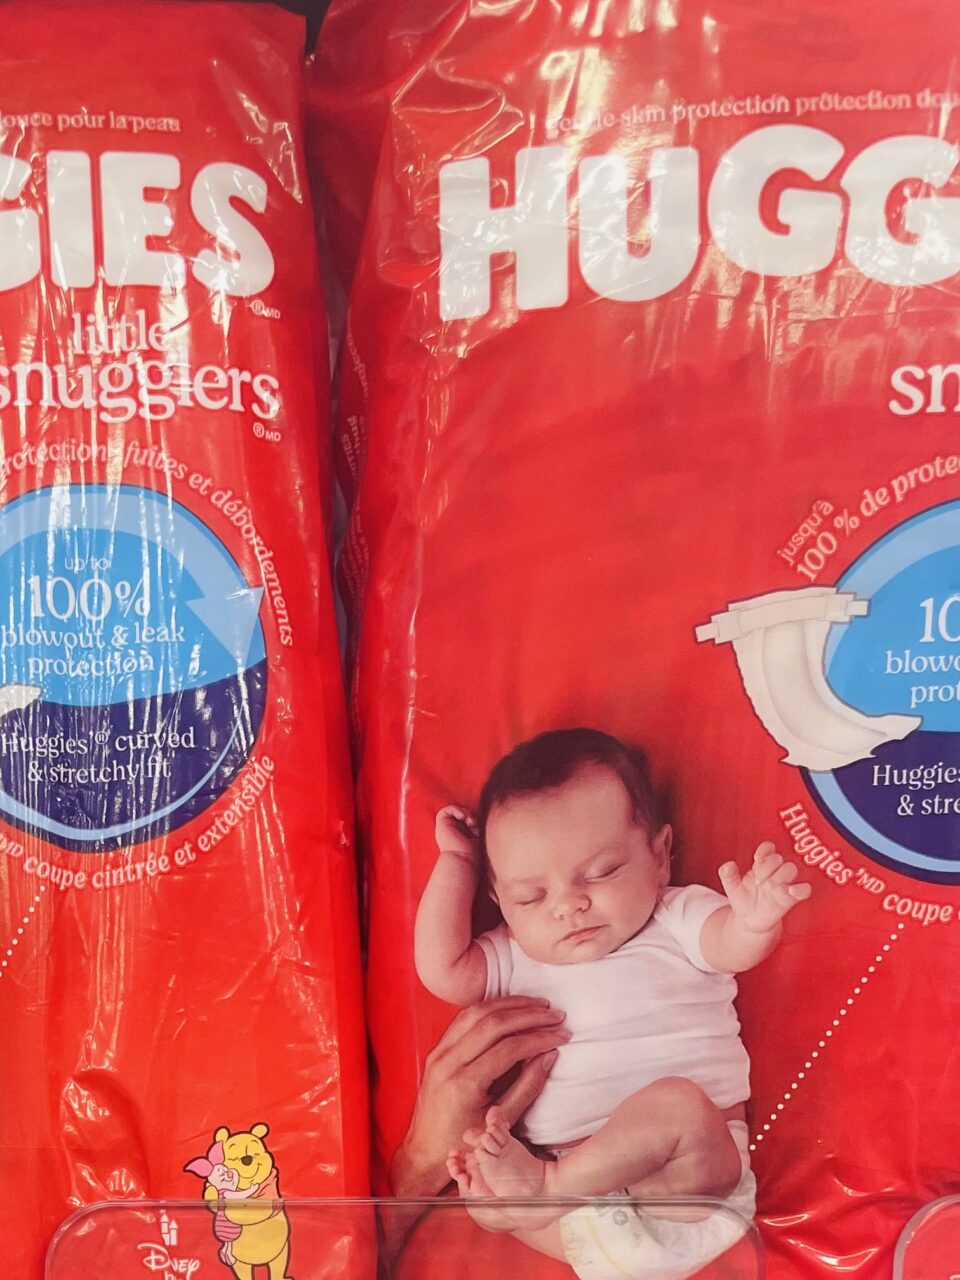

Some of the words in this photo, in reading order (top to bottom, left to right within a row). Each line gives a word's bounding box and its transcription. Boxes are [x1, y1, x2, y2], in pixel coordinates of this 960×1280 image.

[58, 108, 105, 132] pour
[71, 309, 172, 355] little
[189, 473, 213, 496] et
[777, 500, 834, 567] jusqu'à
[797, 529, 838, 582] 100
[860, 487, 891, 517] de
[28, 574, 151, 622] 100%
[1, 622, 106, 650] blowout
[134, 621, 186, 645] leak
[114, 726, 196, 752] curved
[49, 759, 139, 785] stretchy
[147, 755, 172, 779] fit
[897, 794, 914, 816] &
[23, 855, 87, 891] coupe
[92, 850, 171, 890] cintrée
[173, 842, 197, 868] et
[197, 753, 276, 853] extensible
[882, 893, 953, 924] coupe
